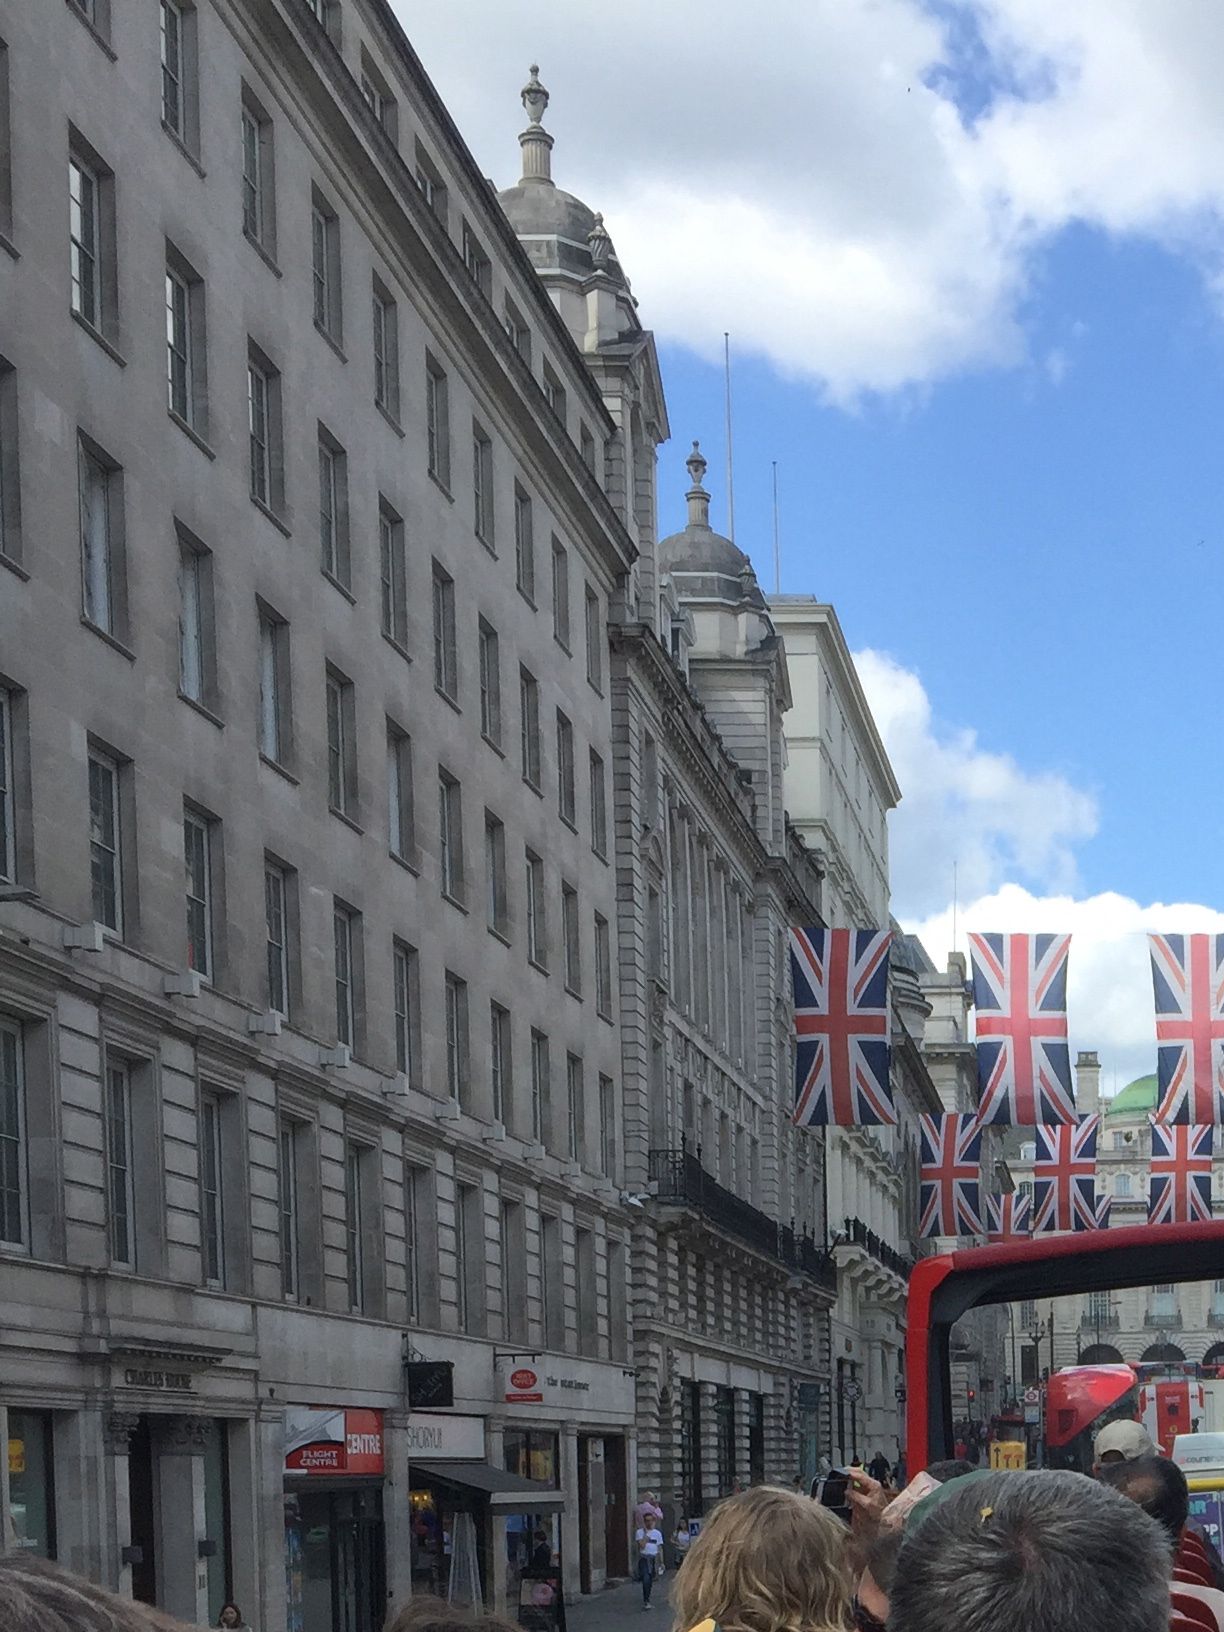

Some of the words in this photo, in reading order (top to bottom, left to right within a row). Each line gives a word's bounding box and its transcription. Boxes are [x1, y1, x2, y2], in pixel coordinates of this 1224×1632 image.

[346, 1433, 380, 1454] CENTRE
[302, 1450, 338, 1458] FLIGHT
[300, 1458, 338, 1467] CENTRE
